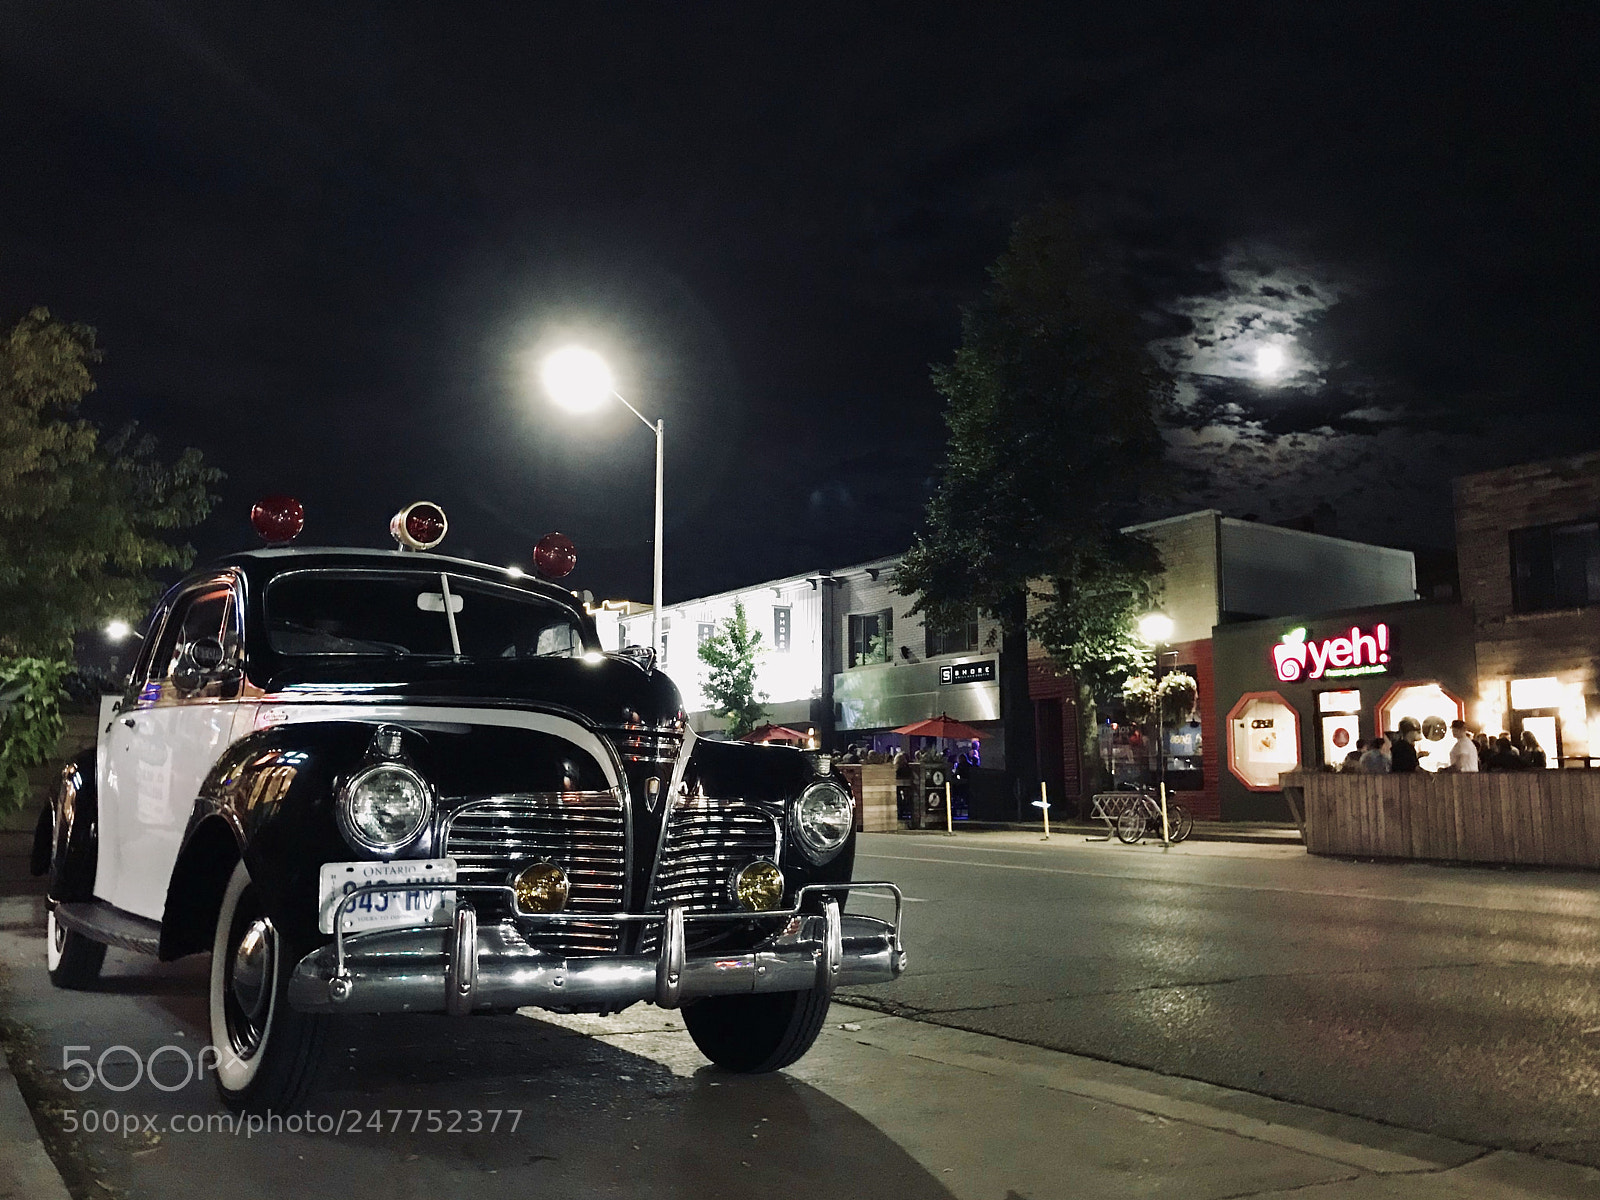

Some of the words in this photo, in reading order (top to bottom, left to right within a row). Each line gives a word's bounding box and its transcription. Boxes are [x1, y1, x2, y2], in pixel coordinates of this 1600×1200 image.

[1307, 623, 1388, 679] yeh!
[954, 666, 990, 676] SHORE
[363, 865, 417, 878] ONTARIO
